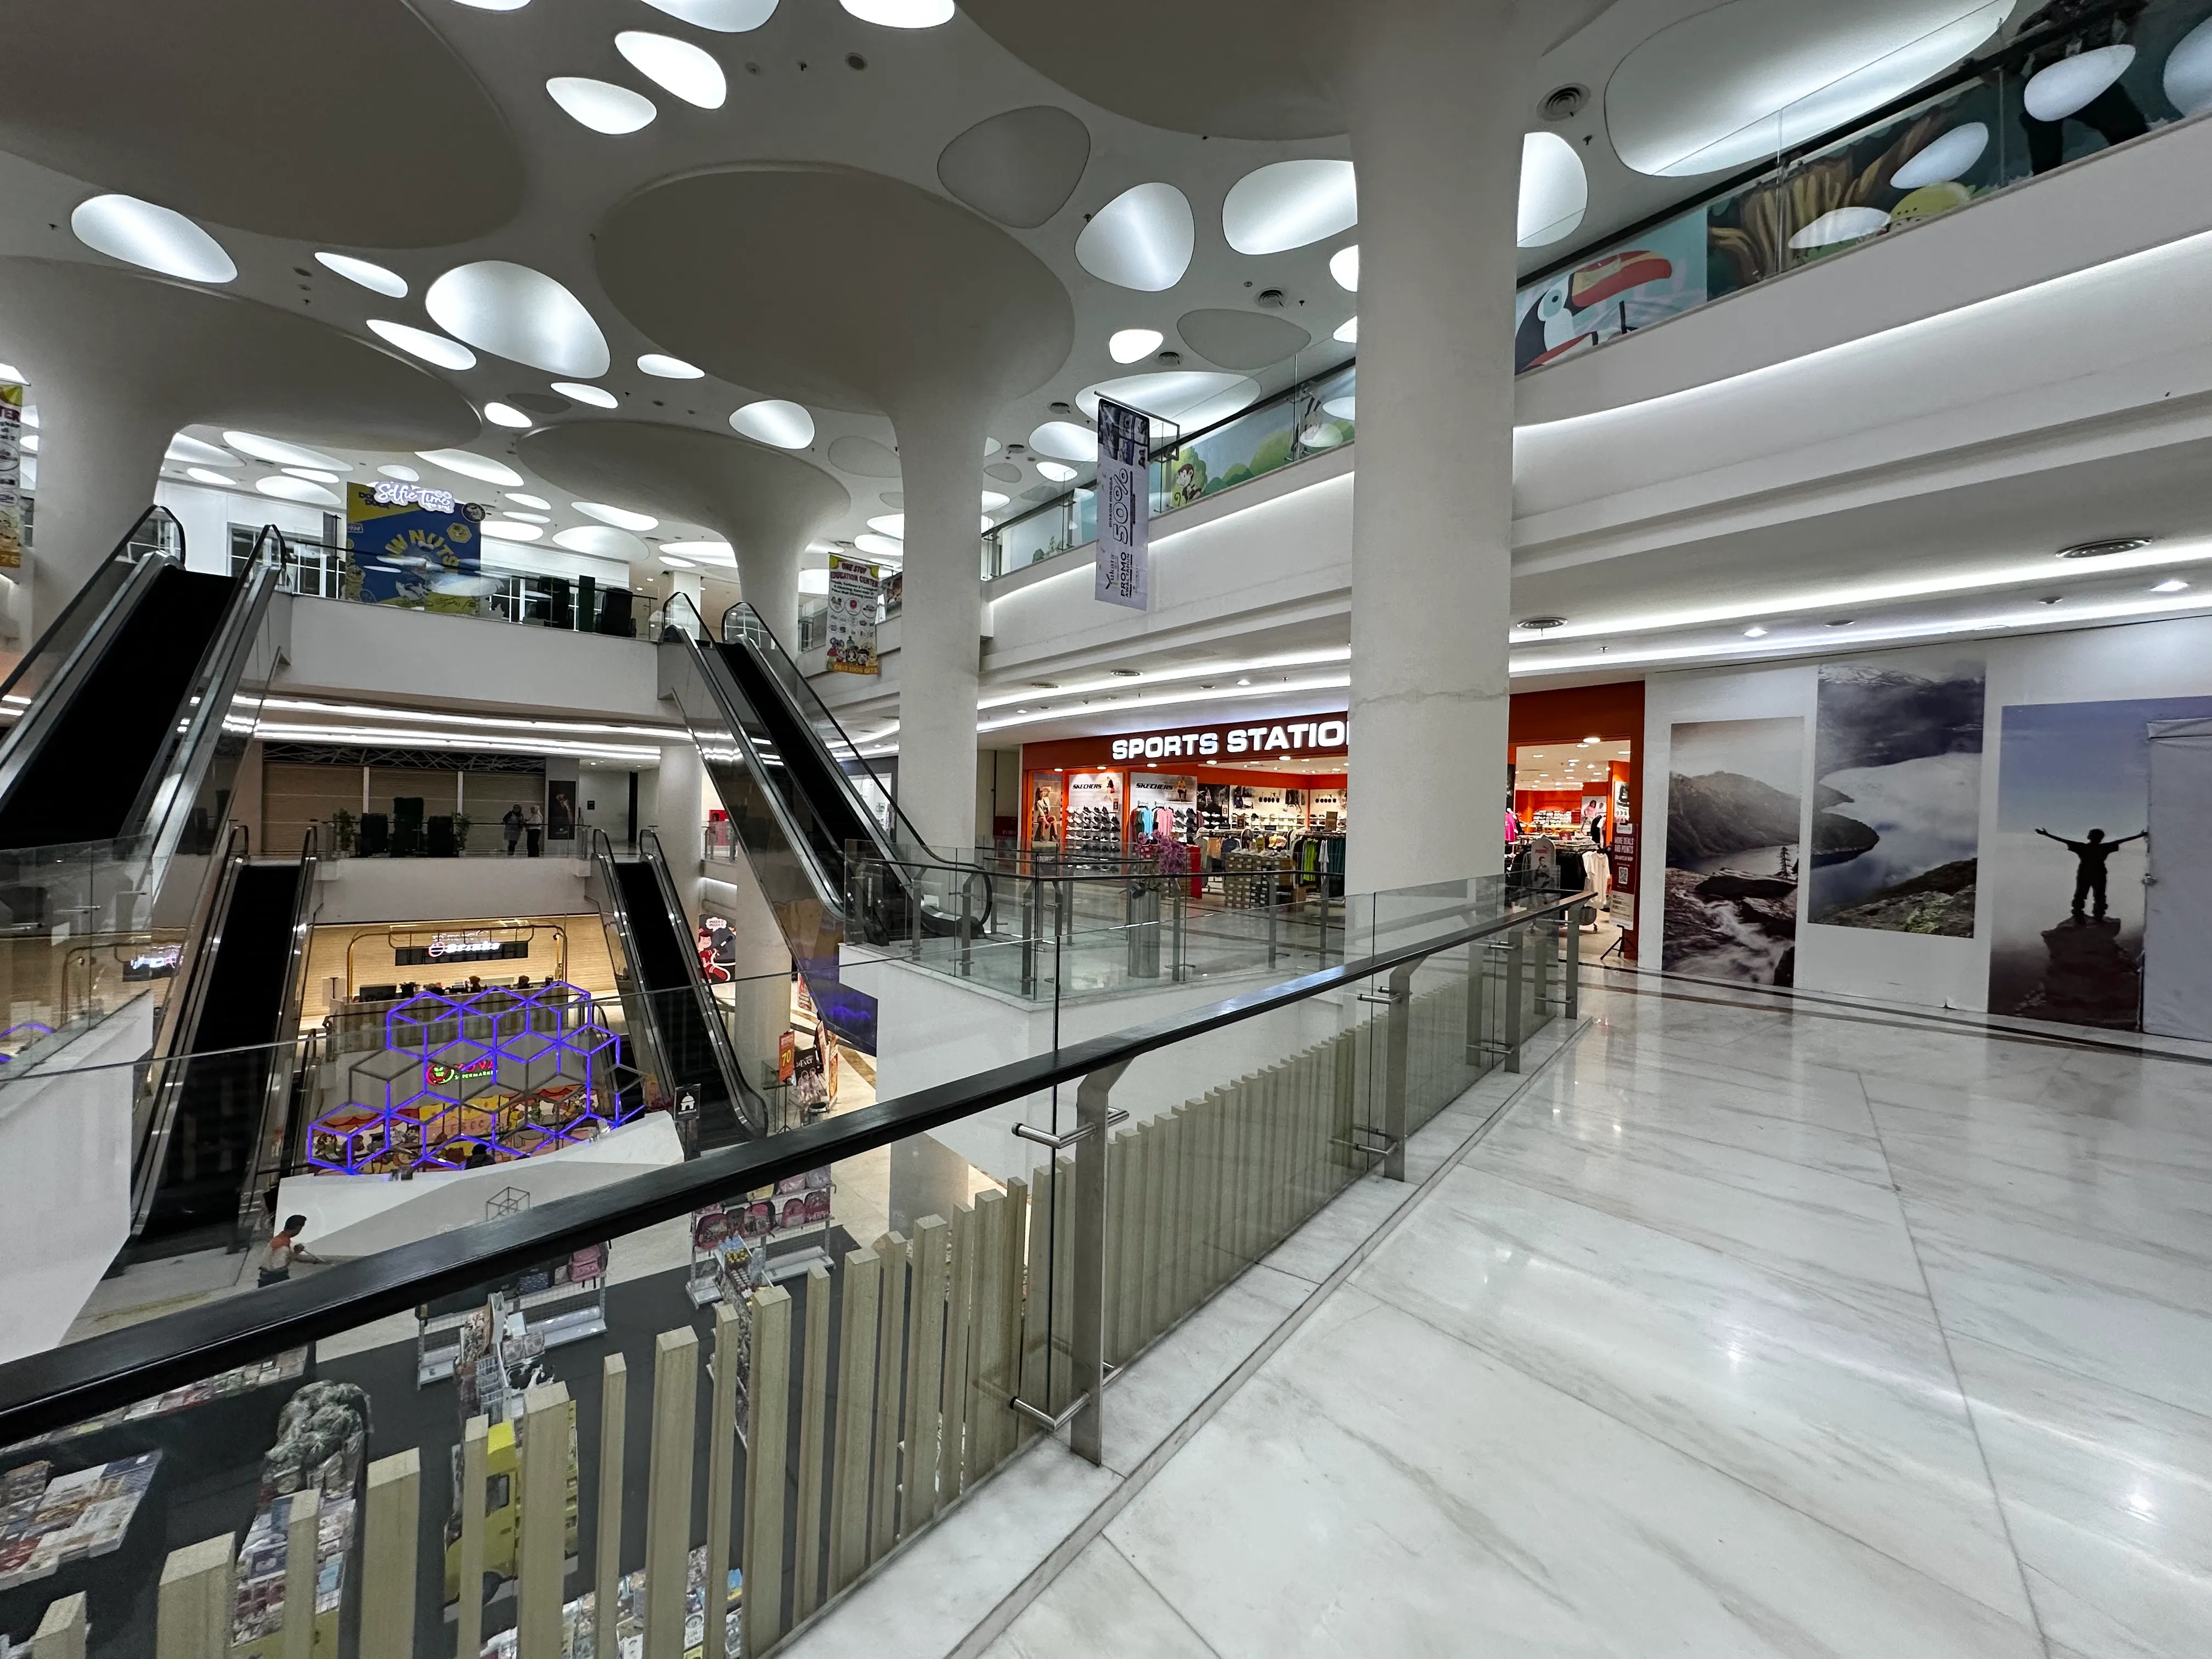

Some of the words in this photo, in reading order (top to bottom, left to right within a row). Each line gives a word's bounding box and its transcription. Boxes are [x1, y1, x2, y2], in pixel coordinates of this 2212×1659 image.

[378, 483, 418, 504] Selfie
[1113, 468, 1128, 544] 50%
[842, 563, 854, 571] ONE
[853, 566, 867, 574] STOP
[830, 571, 858, 582] EDUCATION
[859, 575, 878, 588] CENTER
[1111, 733, 1218, 760] SPORTS
[1227, 720, 1348, 753] STATIO
[781, 1049, 791, 1067] 70
